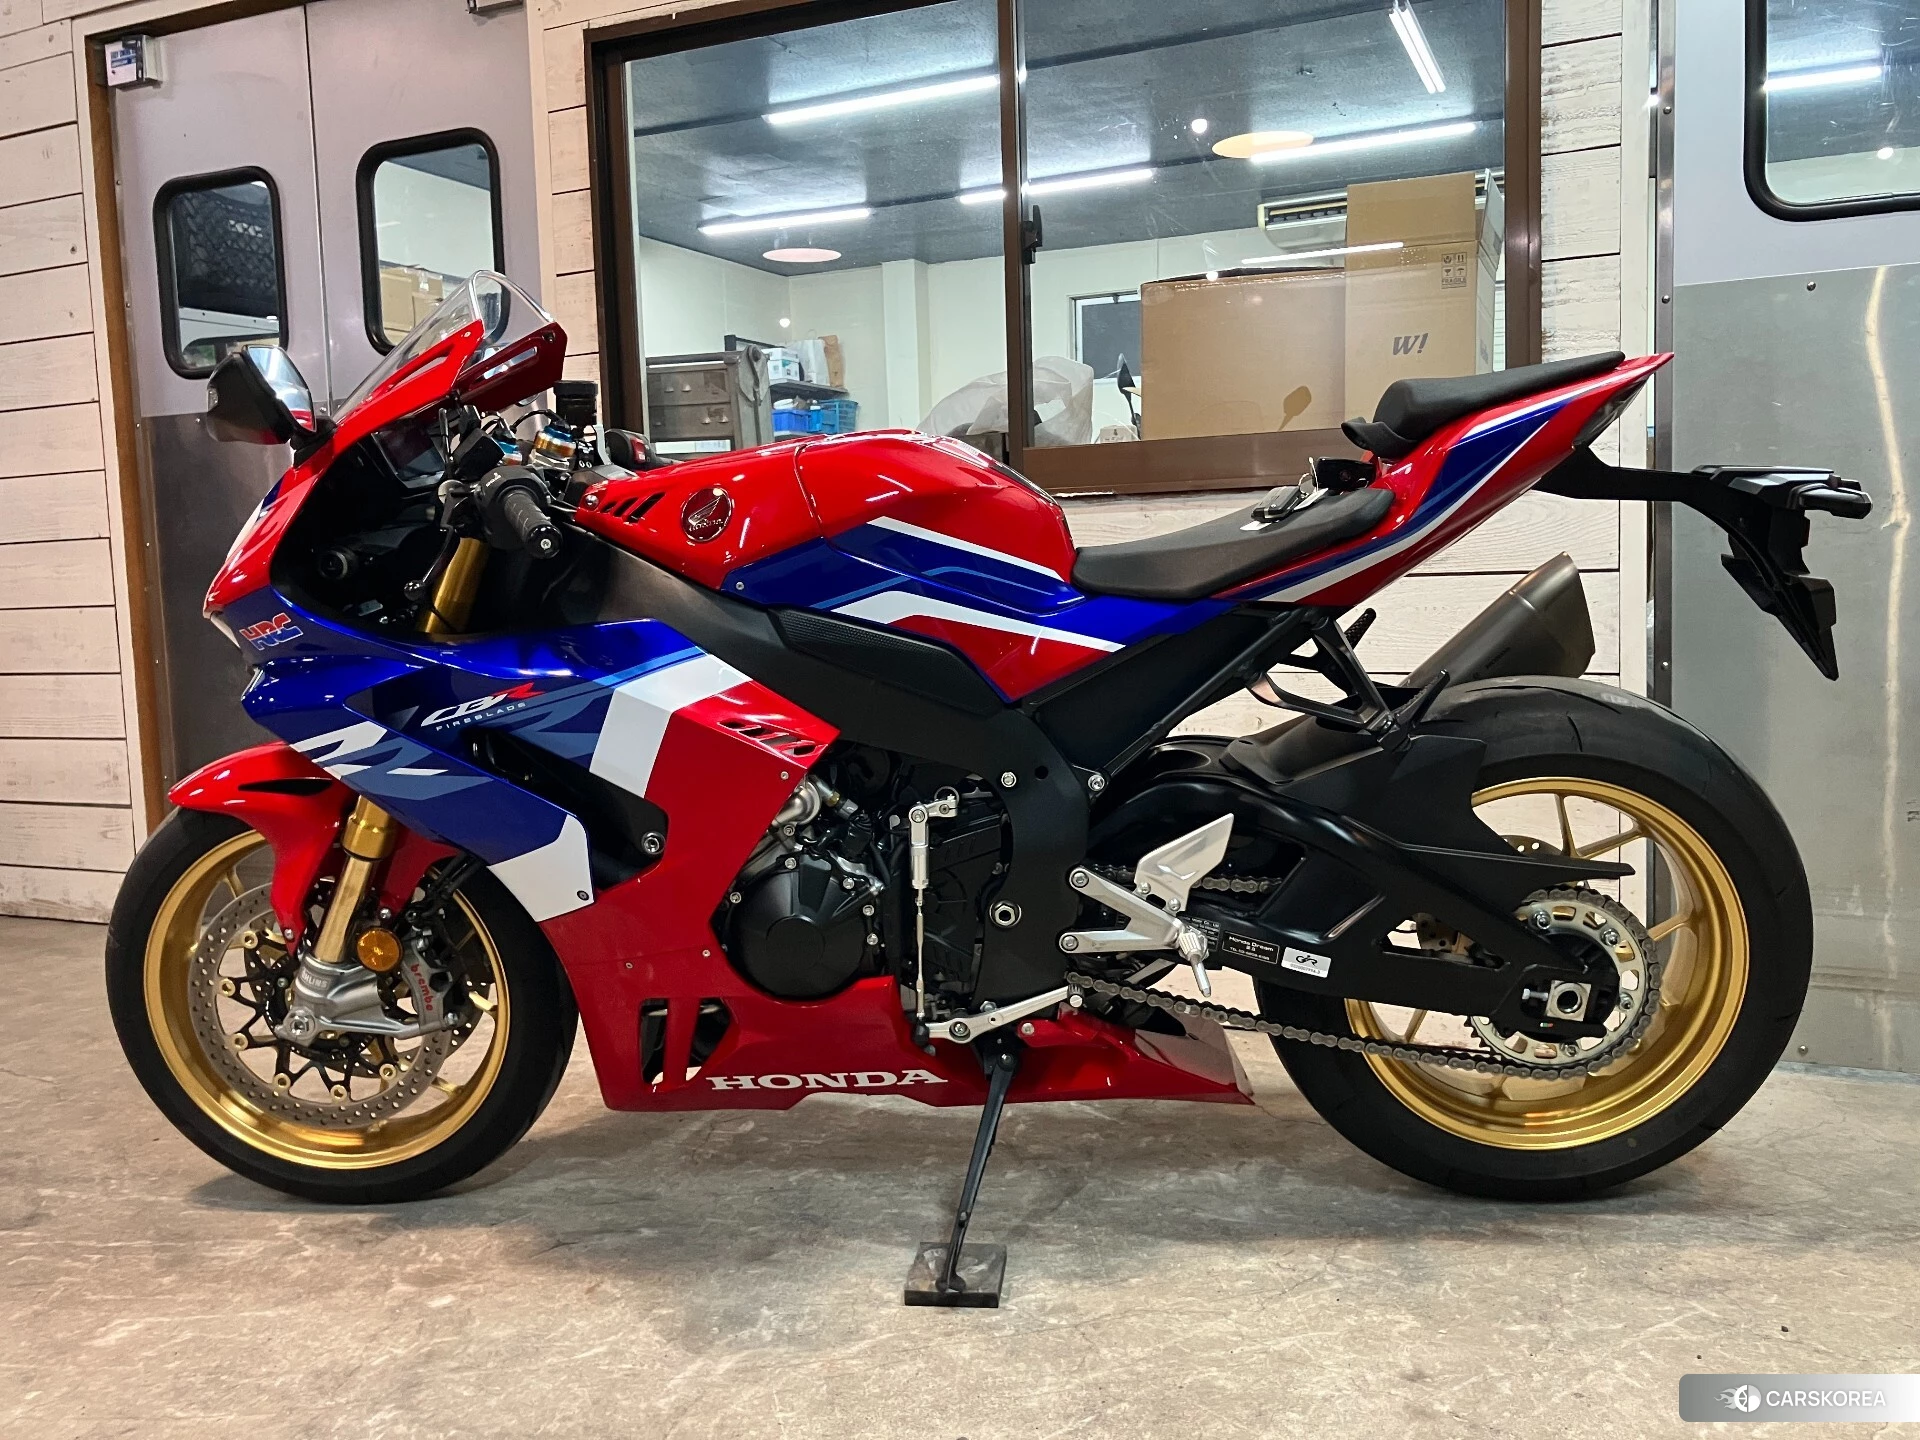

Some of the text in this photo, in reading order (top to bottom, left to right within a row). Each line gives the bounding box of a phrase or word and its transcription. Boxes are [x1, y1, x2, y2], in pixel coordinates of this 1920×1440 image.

[1393, 333, 1428, 355] W!
[239, 612, 304, 651] HRC
[435, 702, 526, 731] FIREBLADE
[1229, 936, 1250, 945] Honda
[1251, 942, 1273, 951] Dream
[411, 963, 433, 1011] brembo
[706, 1069, 948, 1090] HONDA
